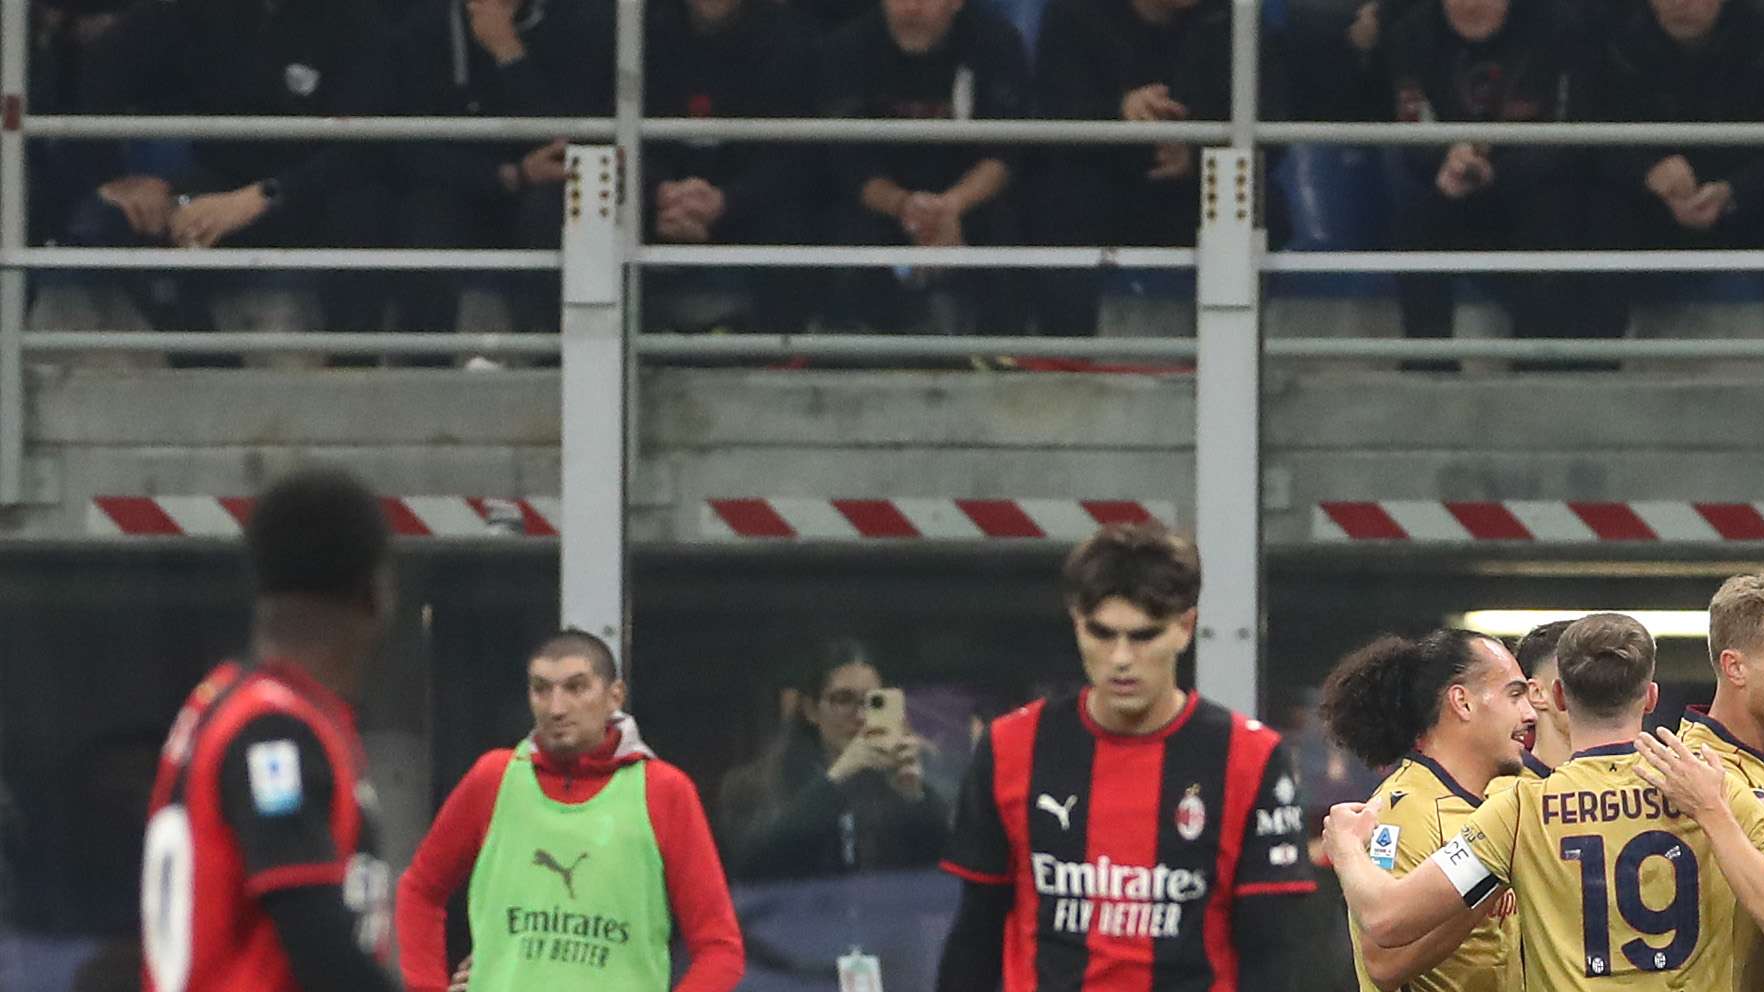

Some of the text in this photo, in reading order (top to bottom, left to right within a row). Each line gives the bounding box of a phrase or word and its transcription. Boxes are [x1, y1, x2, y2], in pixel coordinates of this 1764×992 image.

[1542, 786, 1682, 825] FERGUS
[1032, 852, 1207, 902] Emirates
[506, 905, 630, 945] Emirates
[1560, 830, 1700, 978] 19
